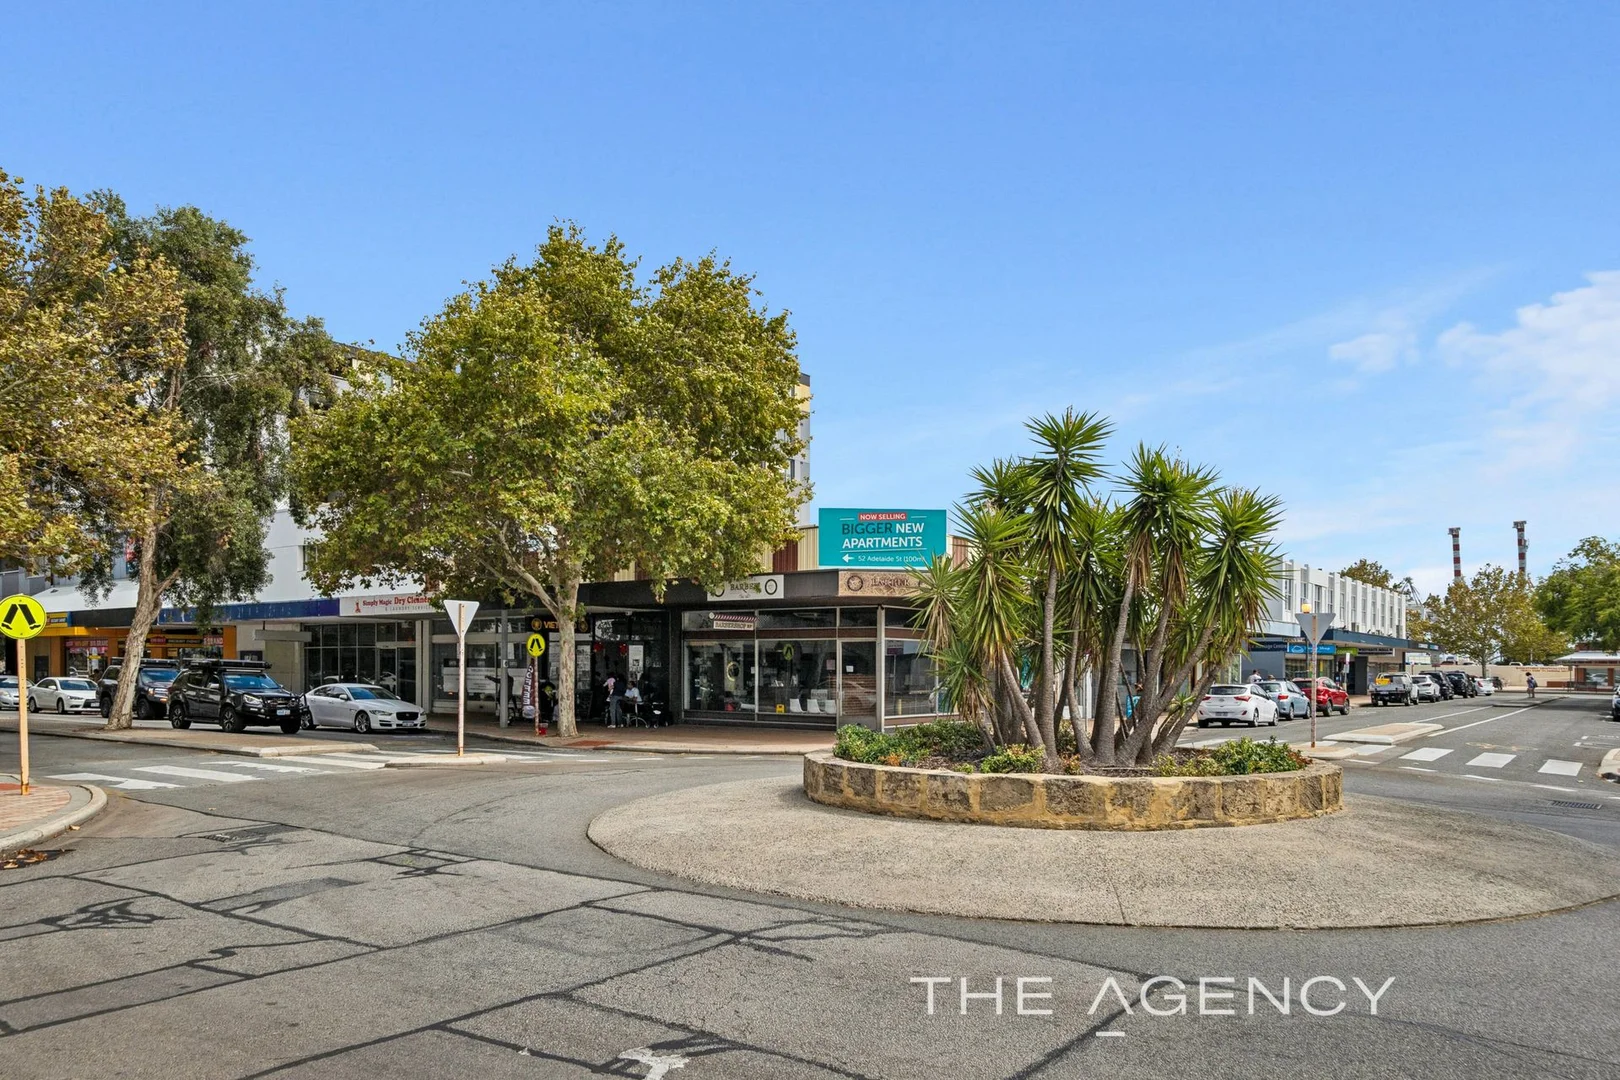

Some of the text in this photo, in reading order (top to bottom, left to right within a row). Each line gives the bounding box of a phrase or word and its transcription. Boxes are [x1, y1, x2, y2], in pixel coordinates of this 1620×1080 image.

[842, 522, 924, 535] BIGGER NEW
[842, 536, 923, 549] APARTMENTS
[867, 554, 894, 562] Adelaide
[903, 555, 925, 563] (100m
[730, 582, 760, 593] BARBE
[394, 596, 405, 605] Dry
